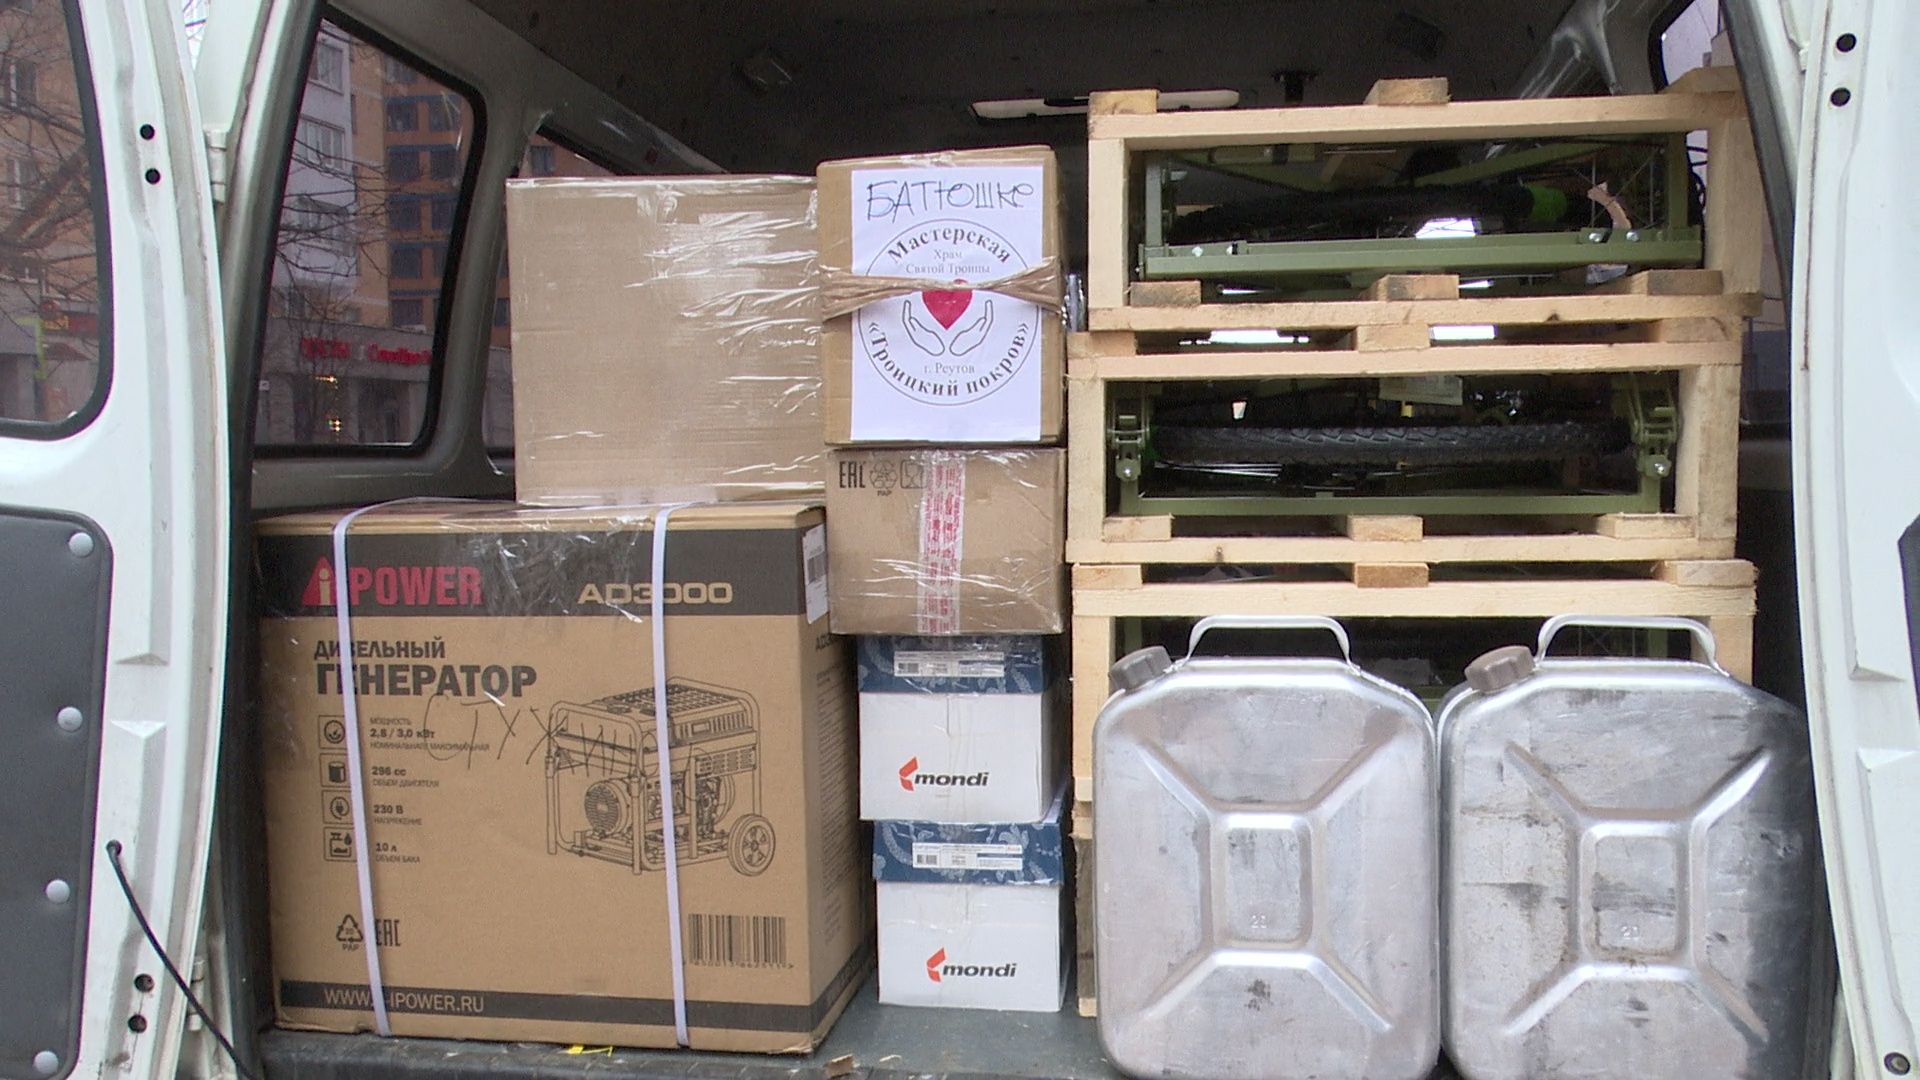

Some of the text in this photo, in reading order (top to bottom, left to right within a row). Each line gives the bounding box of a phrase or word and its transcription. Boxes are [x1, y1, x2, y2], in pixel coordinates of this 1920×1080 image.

[887, 227, 1011, 264] Мастерская
[933, 249, 963, 260] Храм
[905, 263, 945, 274] Святой
[966, 322, 1029, 395] покров»
[935, 362, 976, 376] Реутов
[577, 582, 734, 605] AD3000
[914, 772, 990, 787] mondi
[373, 804, 393, 814] 230
[375, 842, 389, 852] 10
[942, 963, 1018, 978] mondi
